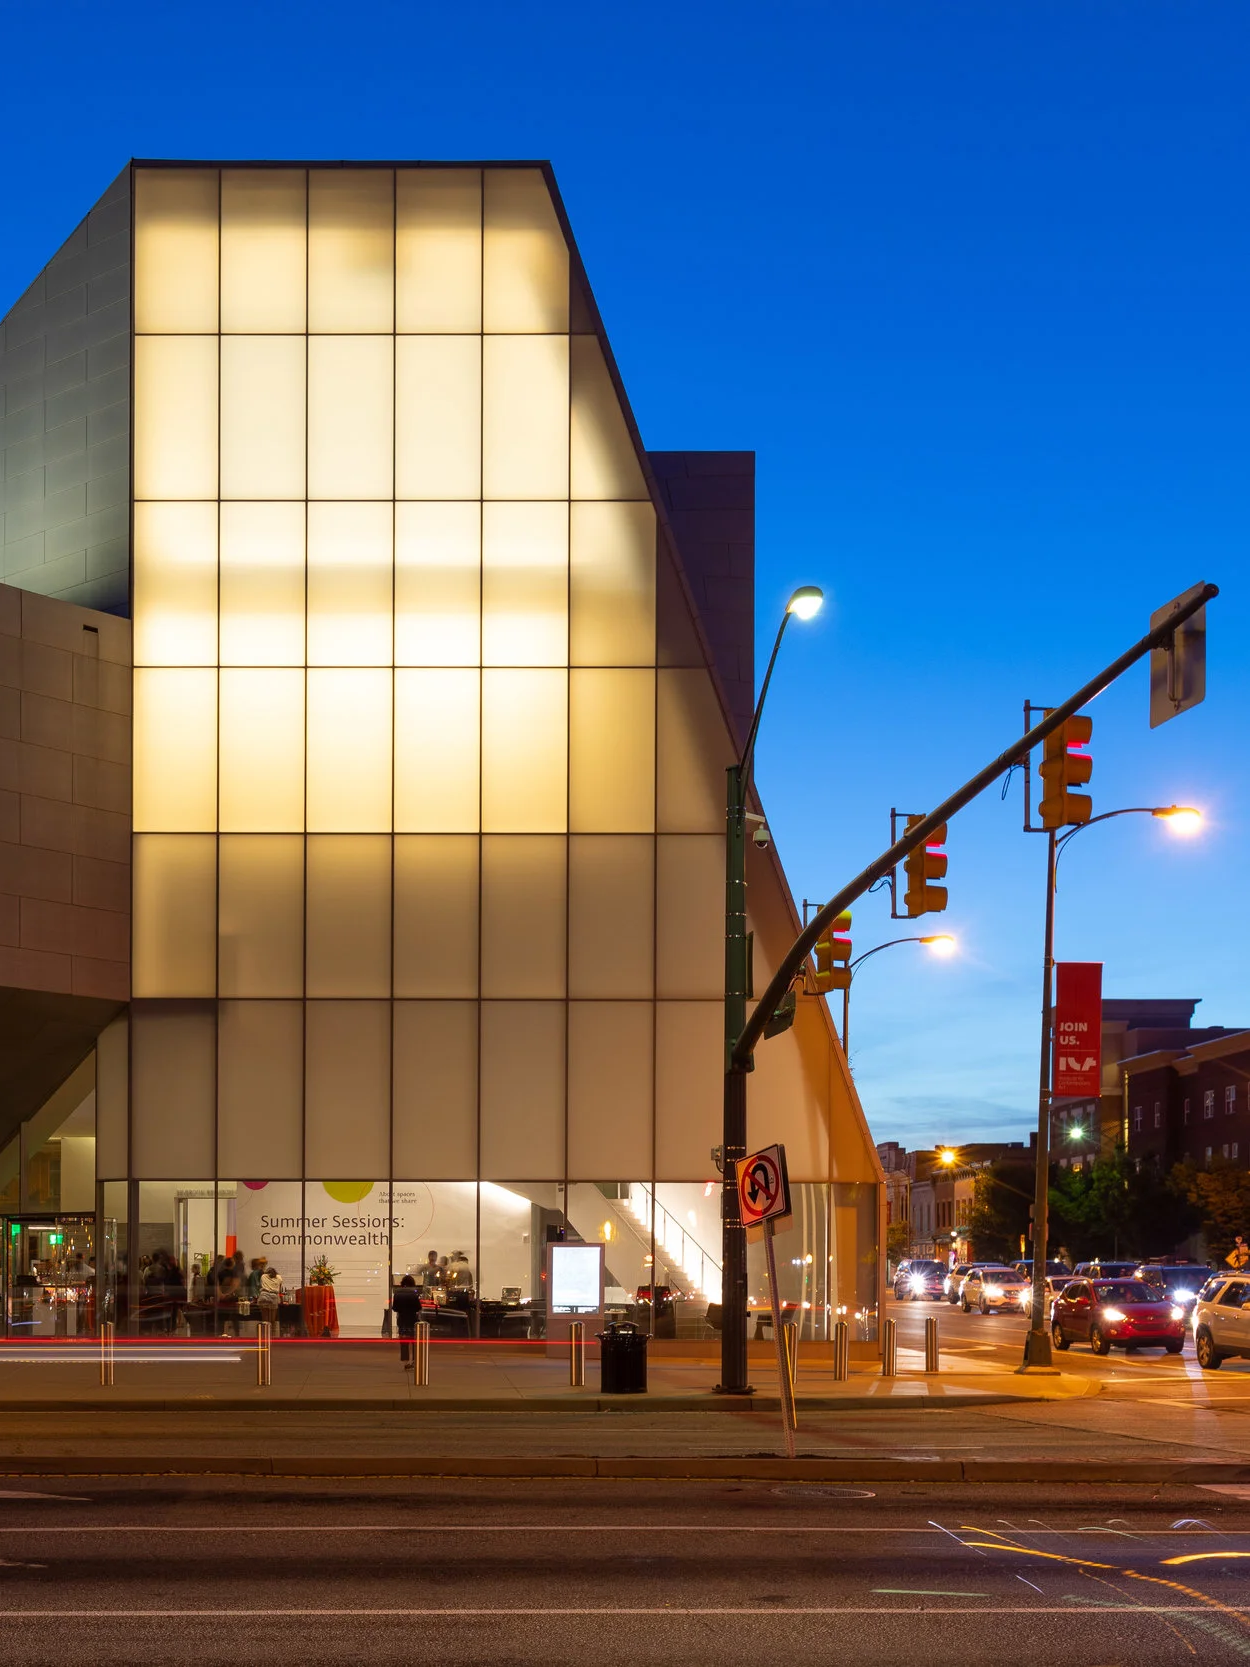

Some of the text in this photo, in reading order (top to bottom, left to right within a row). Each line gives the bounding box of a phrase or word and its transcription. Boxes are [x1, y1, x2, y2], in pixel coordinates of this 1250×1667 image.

[1059, 1022, 1088, 1032] JOIN
[1059, 1036, 1080, 1045] US.
[261, 1215, 327, 1228] Summer
[261, 1232, 389, 1245] Commonwealth
